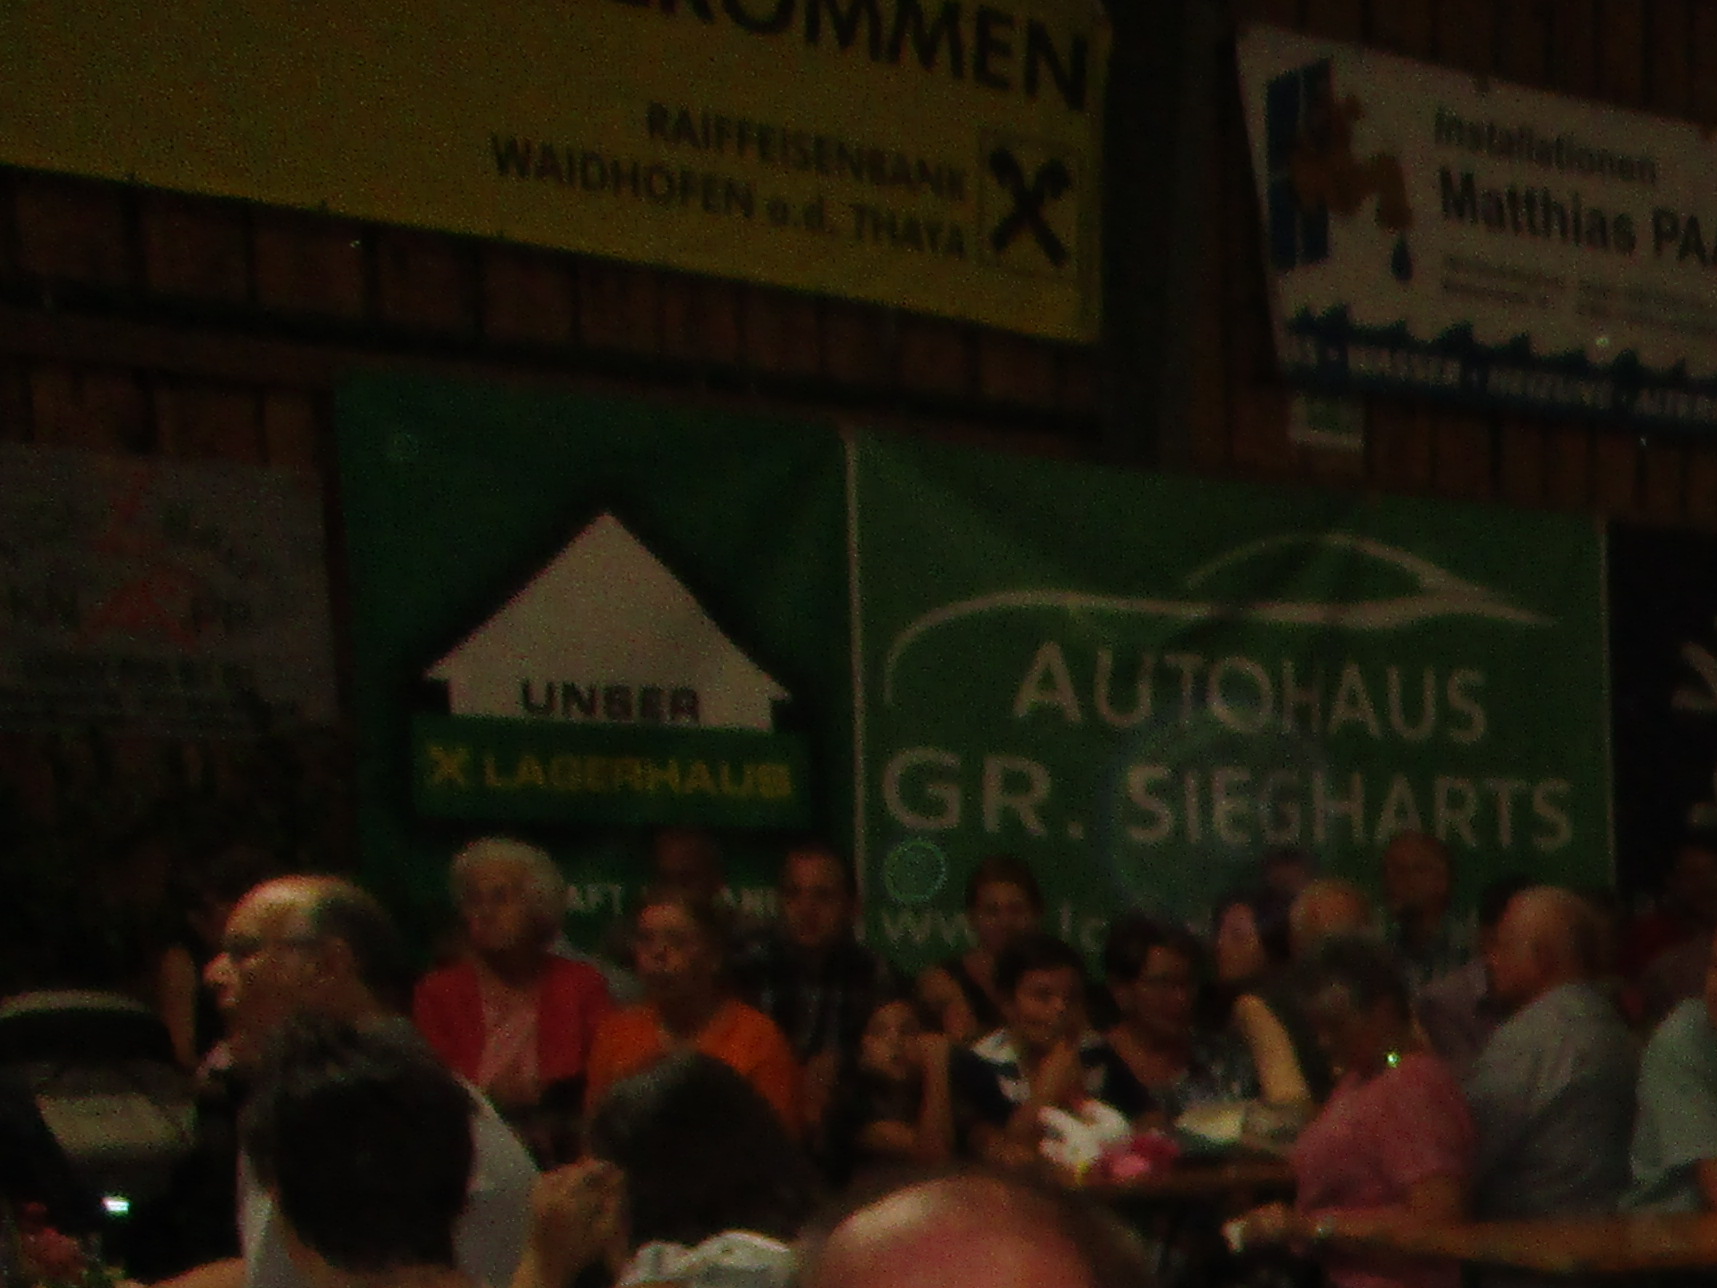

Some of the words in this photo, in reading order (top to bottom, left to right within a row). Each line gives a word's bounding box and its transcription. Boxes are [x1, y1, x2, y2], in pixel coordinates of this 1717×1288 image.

[646, 102, 967, 201] RAIFFEISENBANK
[1434, 104, 1658, 186] Installationen
[491, 135, 756, 220] WAIDHOFEN
[849, 202, 967, 258] THAYA
[1439, 167, 1636, 257] Matthias
[522, 678, 702, 724] UNSER
[1014, 641, 1489, 747] AUTOHAUS
[483, 754, 793, 800] LAGERHAUS
[881, 748, 1084, 840] GR.
[1125, 762, 1573, 853] SIEGHARTS
